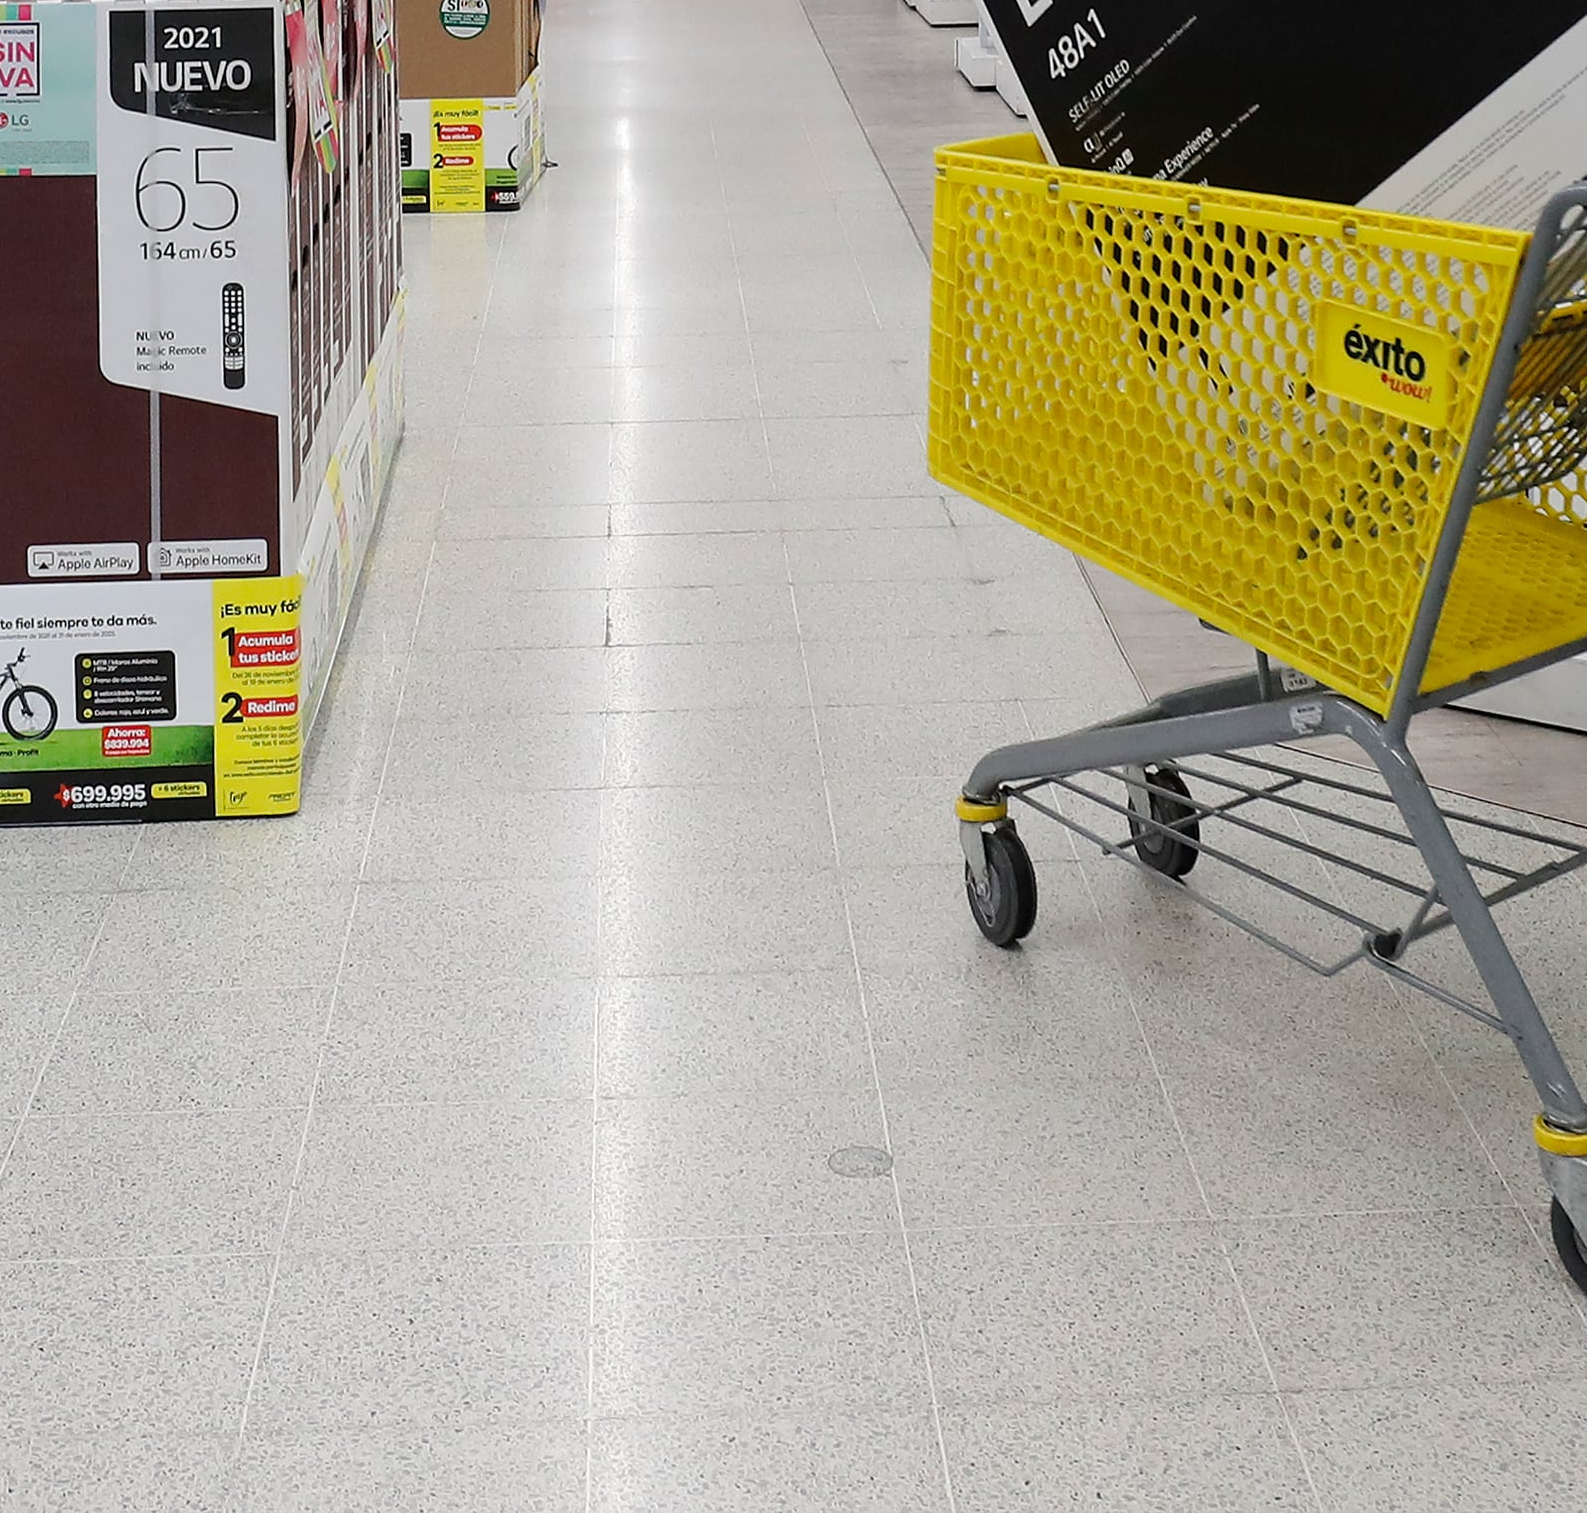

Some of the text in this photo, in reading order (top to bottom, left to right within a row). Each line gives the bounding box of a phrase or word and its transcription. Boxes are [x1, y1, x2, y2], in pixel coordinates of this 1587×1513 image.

[163, 26, 223, 49] 2021
[1047, 8, 1107, 80] 48A1
[133, 59, 252, 93] NUEVO
[11, 114, 30, 126] LG
[1163, 126, 1214, 174] Experience
[134, 147, 240, 232] 65
[136, 331, 175, 341] NUVO
[168, 345, 207, 356] Remote
[57, 555, 135, 573] Apple AirPlay
[175, 552, 263, 569] Apple HomeKit
[244, 602, 278, 617] muy
[15, 617, 35, 629] fiel
[36, 615, 89, 631] siempre
[90, 615, 104, 627] te
[106, 615, 125, 627] da
[221, 627, 294, 658] 1 Acumula
[238, 651, 258, 664] tus
[220, 692, 296, 724] 2 Redime
[63, 784, 147, 804] $699.995
